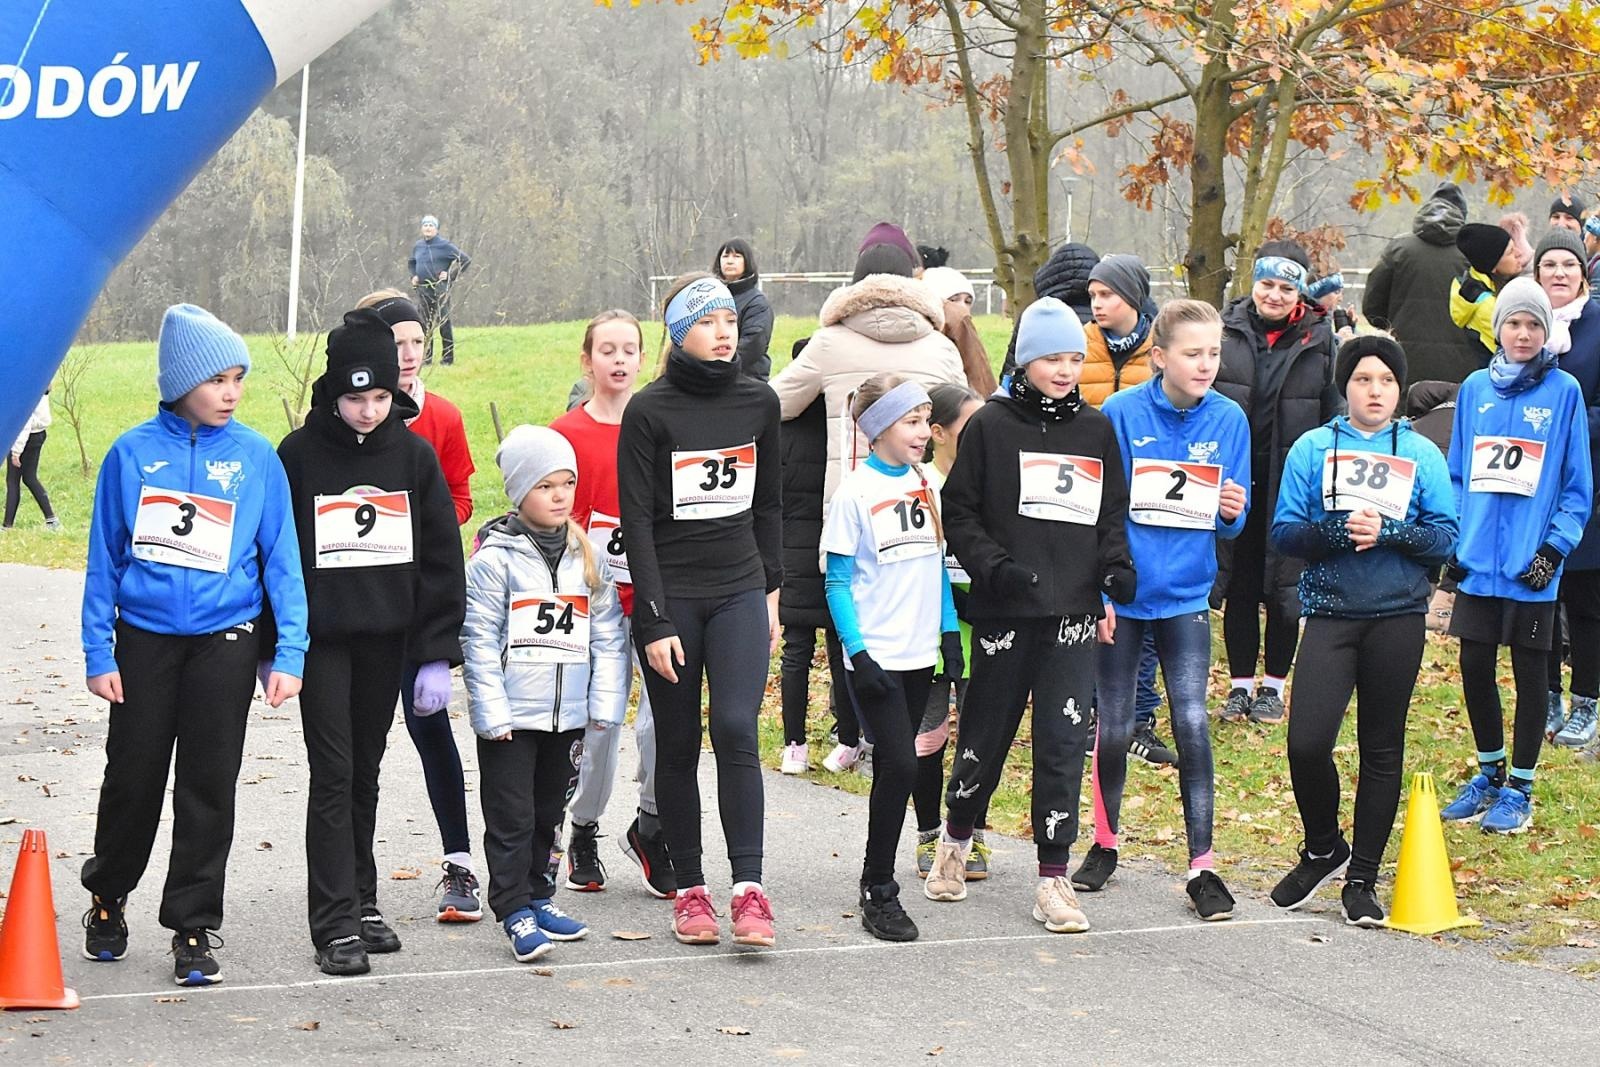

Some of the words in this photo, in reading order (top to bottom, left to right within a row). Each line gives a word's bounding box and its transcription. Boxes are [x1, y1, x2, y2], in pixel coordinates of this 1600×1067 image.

[699, 456, 738, 492] 35
[1345, 458, 1390, 490] 38
[1487, 444, 1523, 471] 20
[1055, 463, 1075, 494] 5
[1165, 469, 1188, 501] 2
[171, 502, 197, 537] 3
[355, 503, 377, 538] 9
[893, 496, 925, 532] 16
[533, 602, 574, 635] 54
